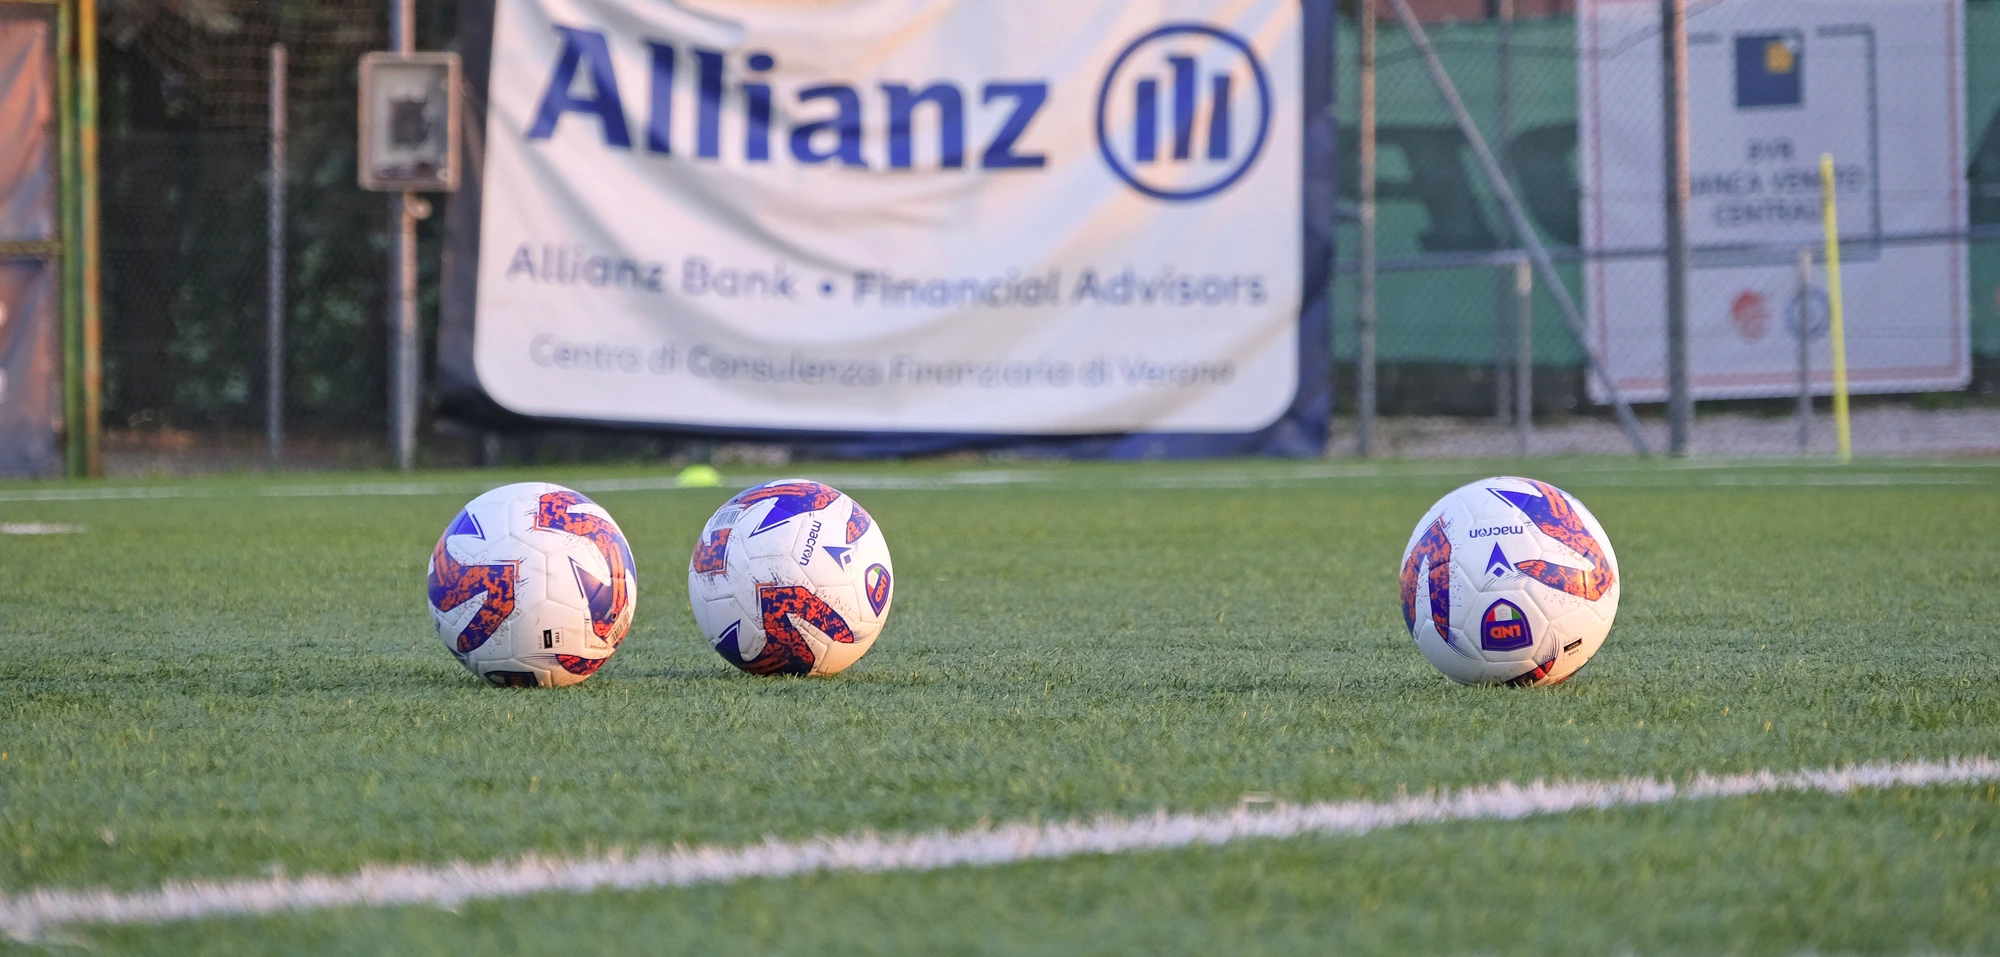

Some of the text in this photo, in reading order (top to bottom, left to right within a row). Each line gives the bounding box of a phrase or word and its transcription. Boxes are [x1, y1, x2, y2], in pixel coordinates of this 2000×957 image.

[526, 23, 1050, 170] Allianz
[1772, 164, 1866, 193] VENTO
[505, 244, 1268, 307] Allianz Bank Financial Advisors
[529, 333, 1237, 388] Centro di Consulenza Finanziaria di Verona
[799, 520, 821, 566] macron
[1470, 526, 1523, 539] macron
[1490, 625, 1521, 639] LND
